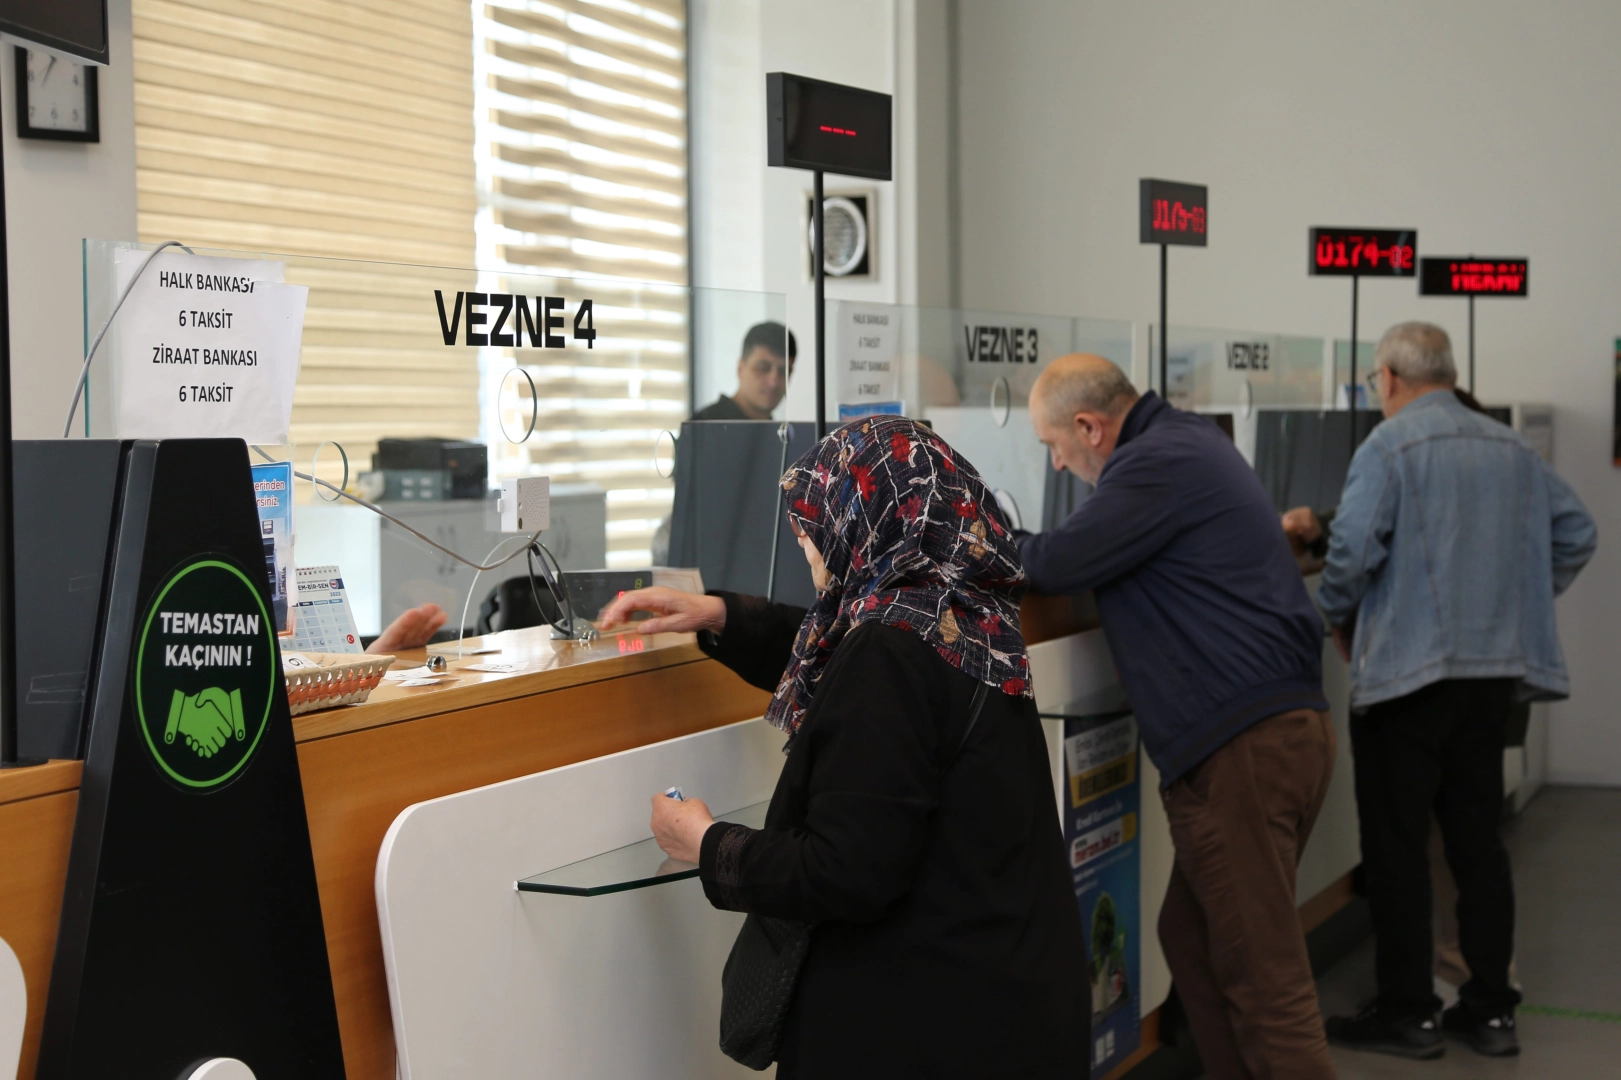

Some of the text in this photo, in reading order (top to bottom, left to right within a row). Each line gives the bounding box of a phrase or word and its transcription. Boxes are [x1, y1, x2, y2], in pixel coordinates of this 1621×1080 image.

[159, 270, 194, 290] HALK
[178, 308, 233, 329] 6 TAKSİT
[434, 289, 596, 349] VEZNE 4
[152, 343, 258, 367] ZİRAAT BANKASI
[964, 324, 1039, 363] VEZNE 3
[1226, 341, 1259, 370] VEZNE
[178, 382, 234, 402] 6 TAKSİT
[253, 478, 285, 492] erinden
[160, 611, 260, 635] TEMASTAN
[165, 644, 242, 672] KAÇININ
